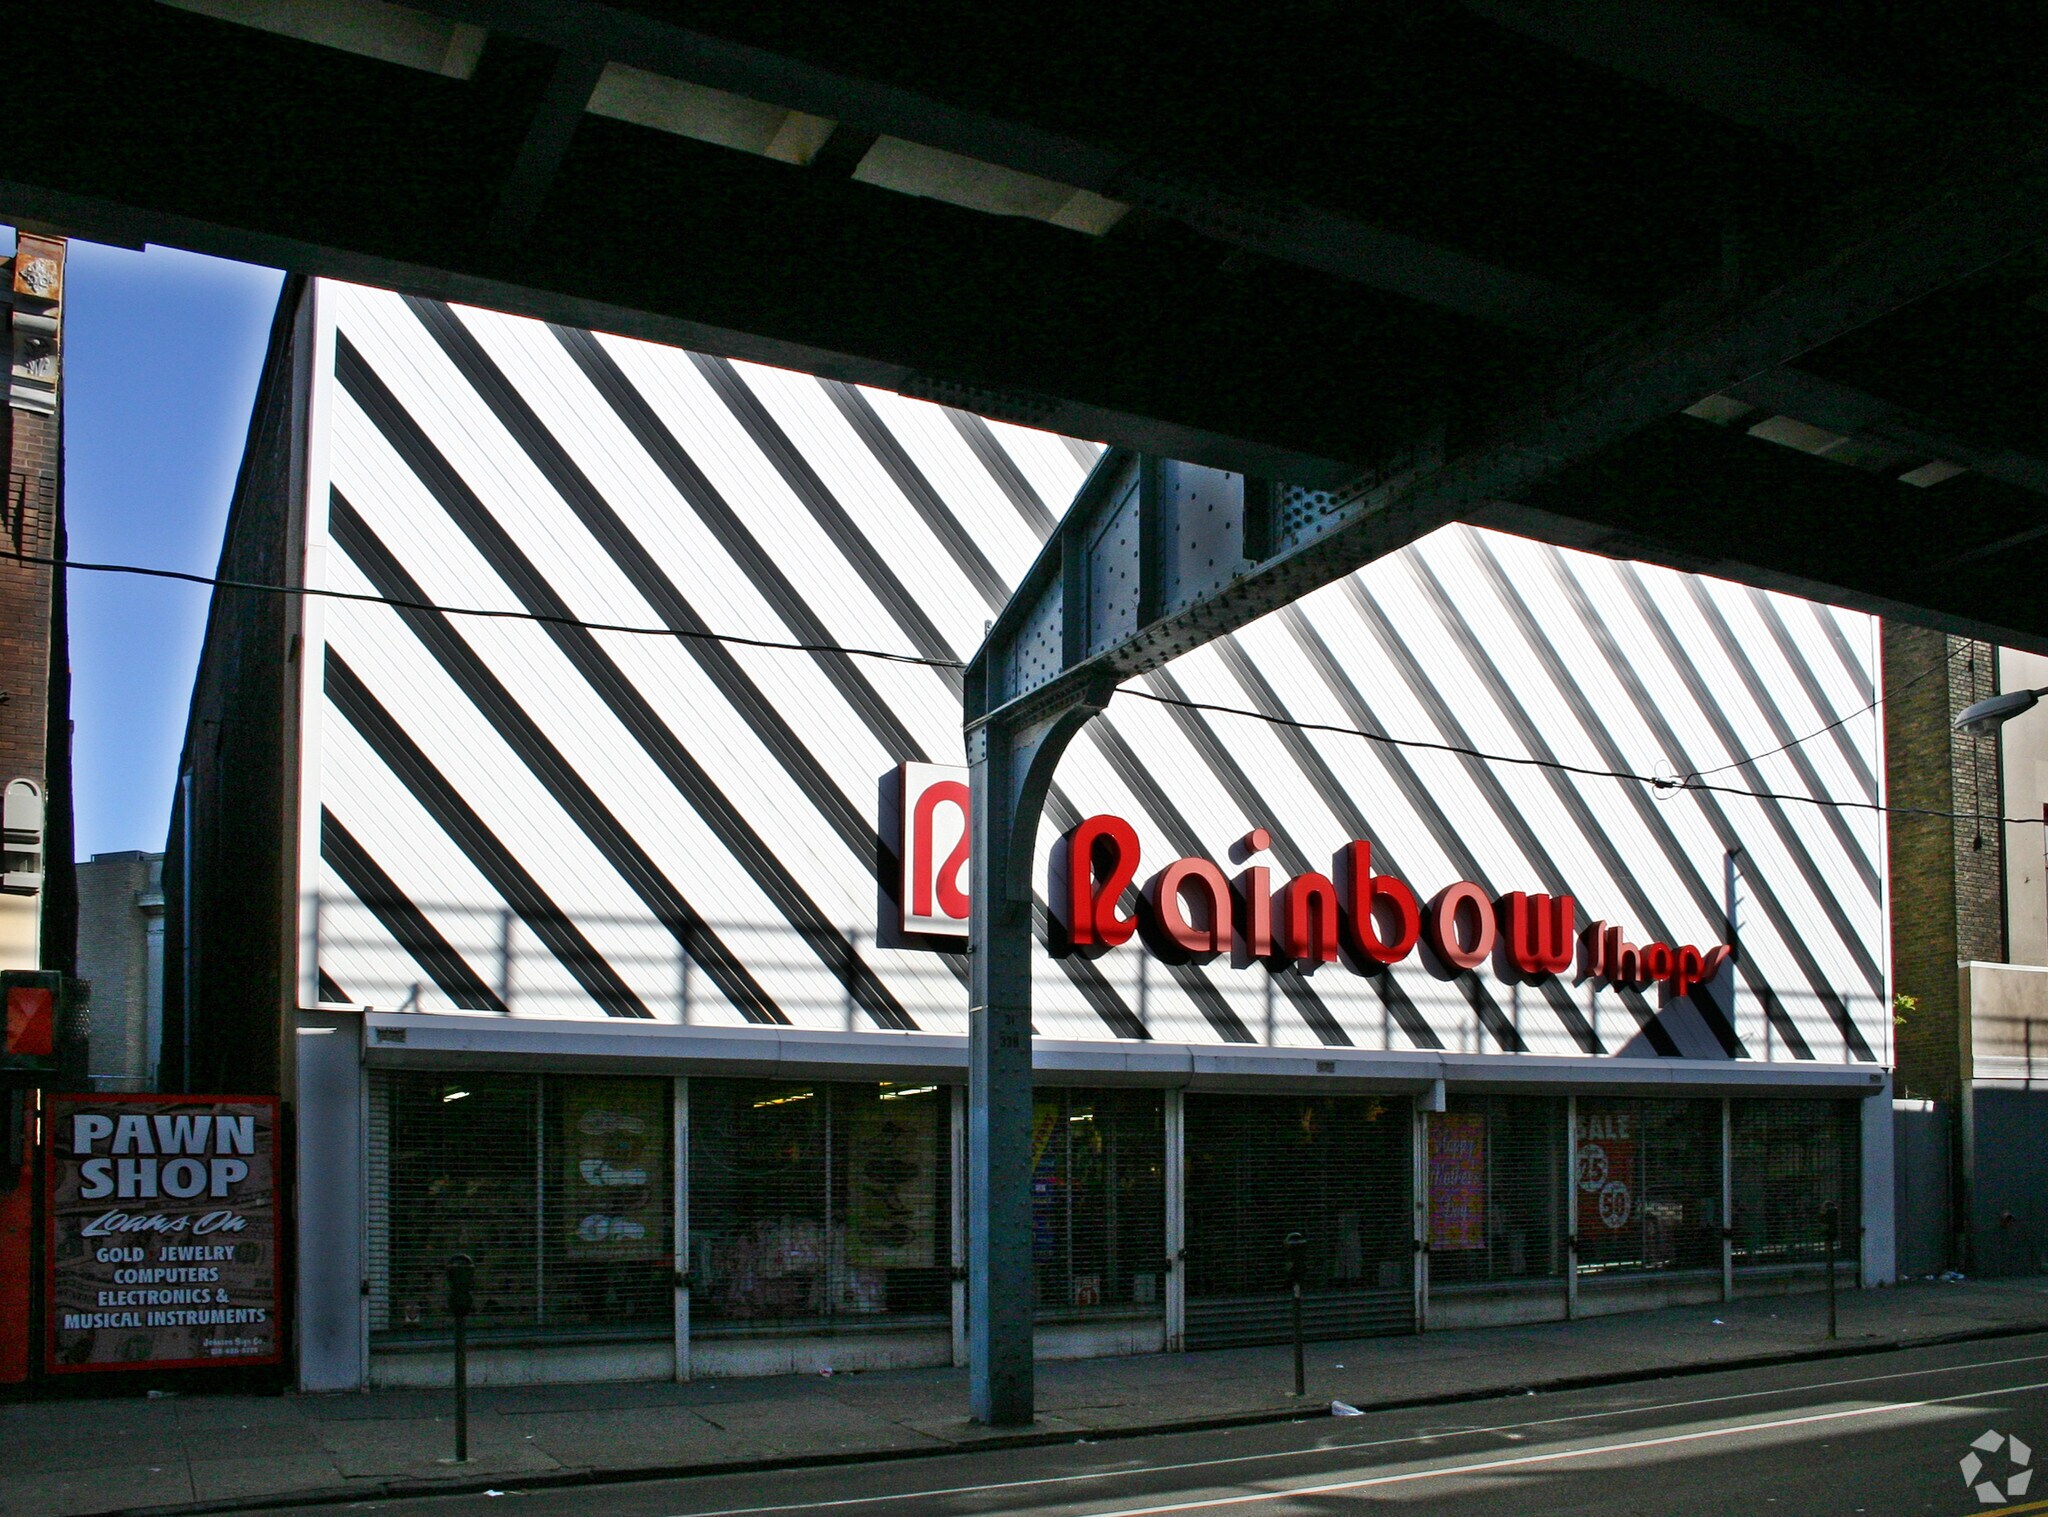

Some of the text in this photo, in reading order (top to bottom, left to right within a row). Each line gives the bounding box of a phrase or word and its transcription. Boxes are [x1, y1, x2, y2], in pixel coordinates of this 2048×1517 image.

[1068, 814, 1732, 997] Rainbow Shops
[72, 1113, 255, 1155] PAWN
[80, 1157, 249, 1200] SHOP
[81, 1208, 250, 1238] Loans On
[96, 1245, 236, 1263] GOLD JEWELRY
[114, 1267, 219, 1284] COMPUTERS
[98, 1288, 230, 1307] ELECTRONICS &
[63, 1308, 266, 1330] MUSICAL INSTRUMENTS
